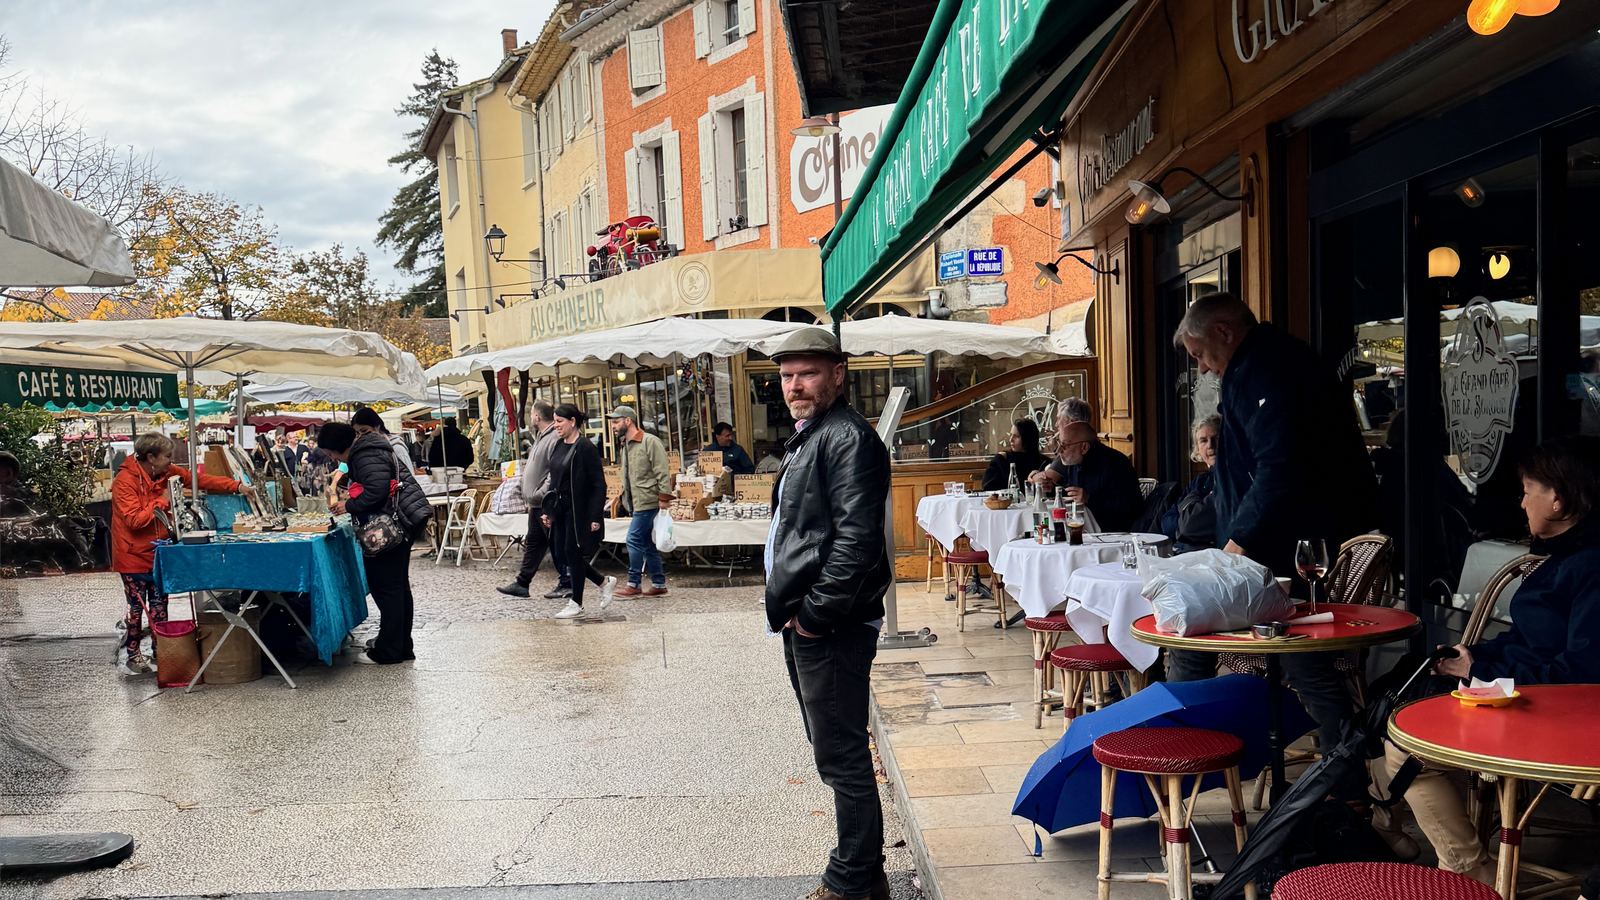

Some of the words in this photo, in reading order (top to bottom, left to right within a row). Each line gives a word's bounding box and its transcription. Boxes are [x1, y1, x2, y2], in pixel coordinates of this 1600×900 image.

[884, 139, 911, 229] GRAND
[920, 45, 950, 180] CAFÉ
[958, 2, 981, 114] DE
[969, 263, 976, 272] LA
[976, 262, 1002, 272] RÉPUBLIQUE
[973, 252, 987, 261] RUE
[988, 251, 997, 260] DE
[530, 305, 545, 338] AU
[546, 288, 607, 333] CHINEUR
[18, 369, 61, 397] CAFÉ
[65, 375, 75, 398] &
[79, 374, 163, 399] RESTAURANT
